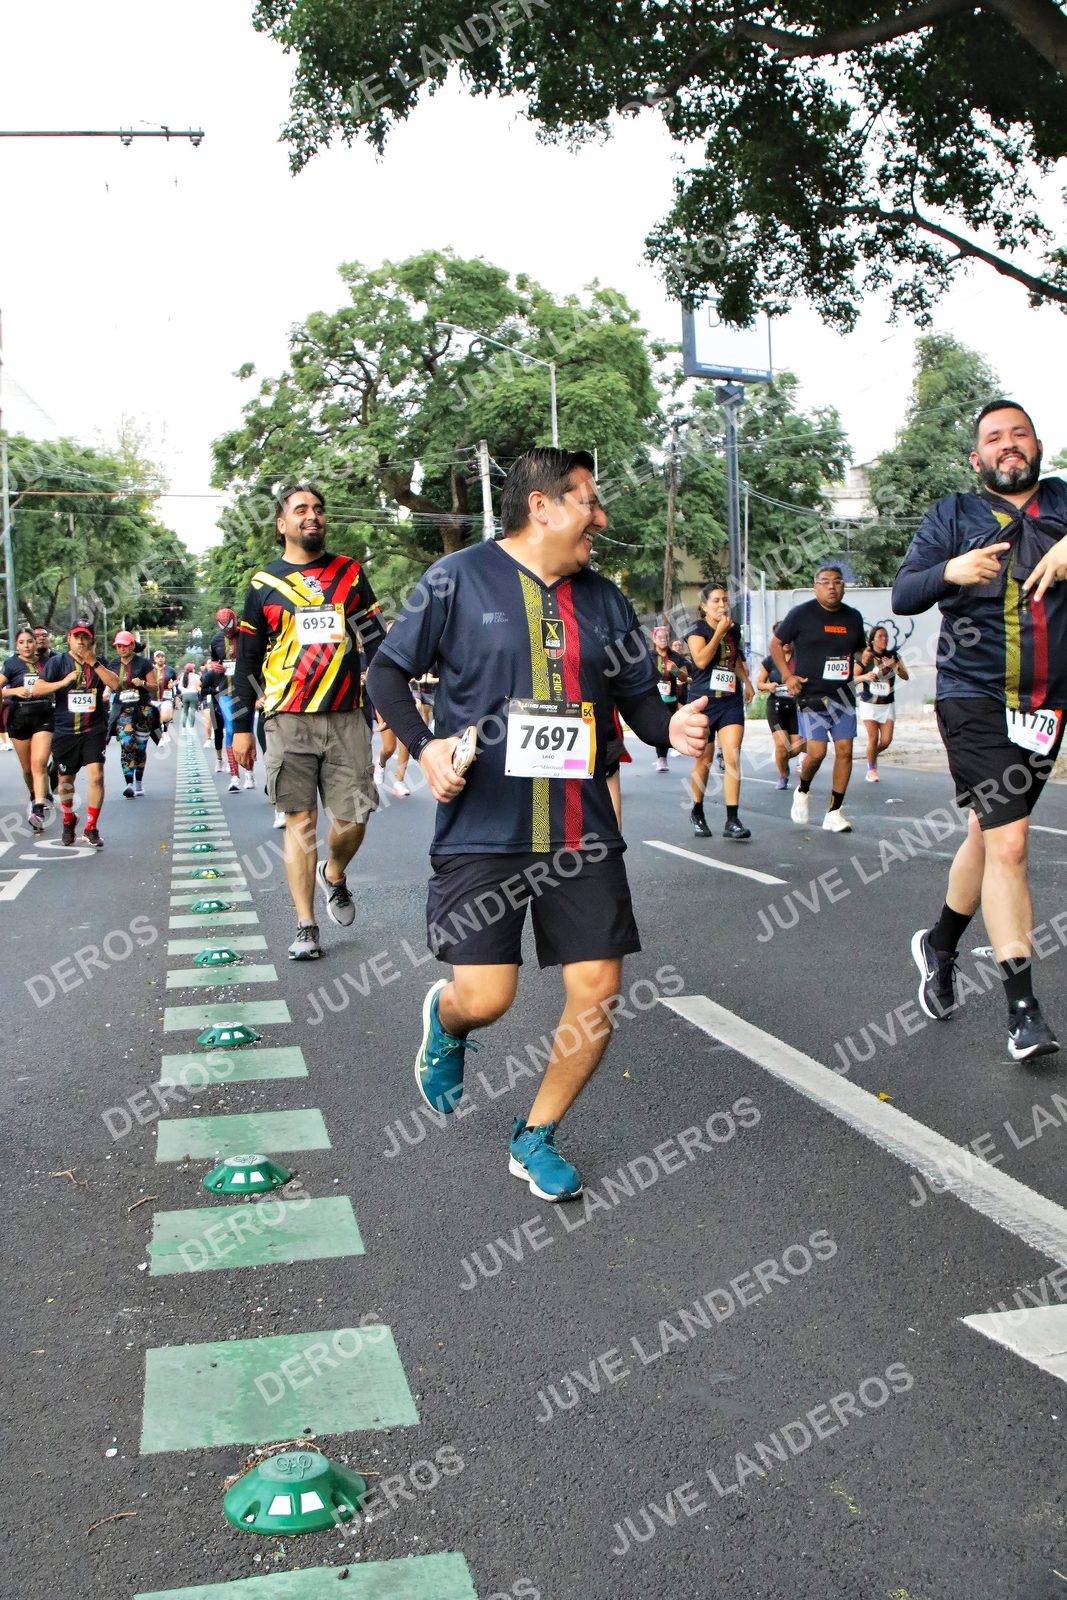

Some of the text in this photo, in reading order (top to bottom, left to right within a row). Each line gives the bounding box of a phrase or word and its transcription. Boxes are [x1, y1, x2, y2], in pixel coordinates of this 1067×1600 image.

[303, 616, 335, 630] 6952
[827, 662, 848, 672] 10025
[715, 673, 734, 683] 4830
[72, 696, 92, 705] 4254
[1010, 709, 1055, 735] 11778
[520, 725, 579, 751] 7697
